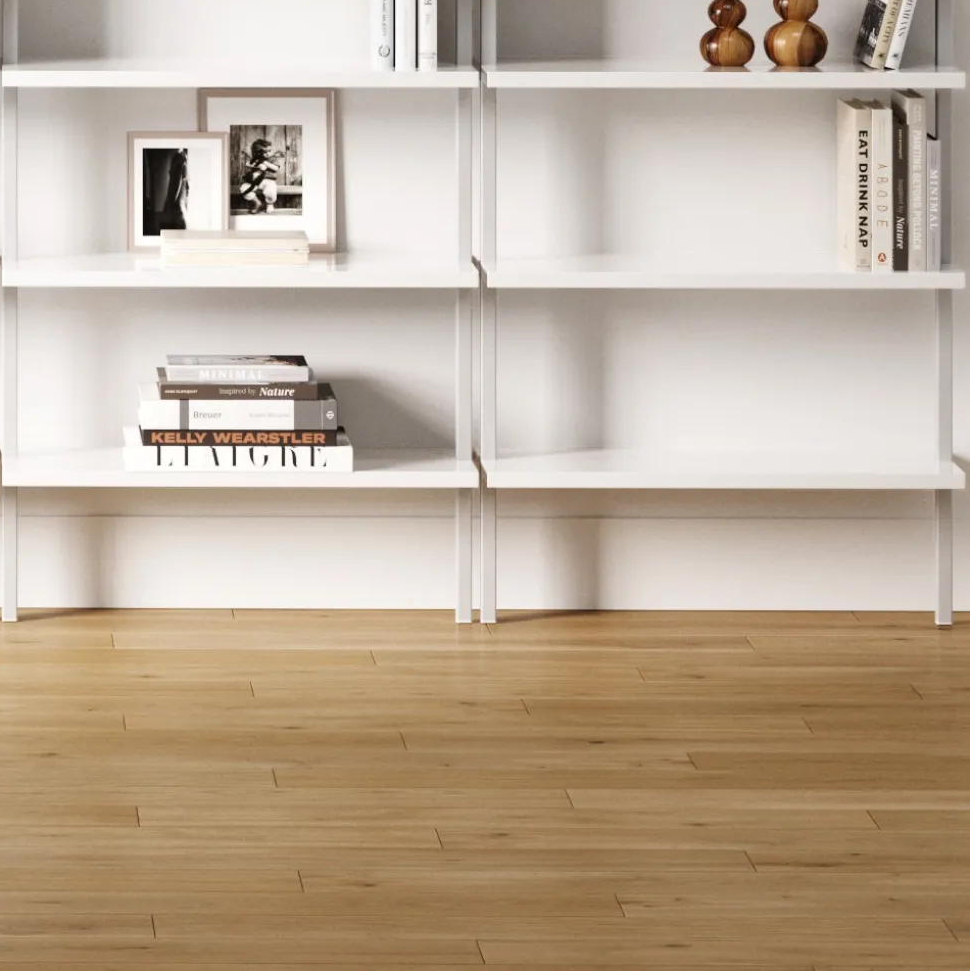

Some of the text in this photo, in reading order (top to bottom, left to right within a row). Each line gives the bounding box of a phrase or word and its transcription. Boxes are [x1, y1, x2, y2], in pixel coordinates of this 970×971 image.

[858, 130, 868, 247] EAT DRINK NAP
[930, 169, 938, 230] MINIMAL
[896, 216, 905, 250] Nature
[199, 369, 264, 380] MINIMAL
[219, 386, 295, 397] Inspired by Nature
[193, 411, 222, 419] Breuer
[151, 432, 326, 444] KELLY WEARSTLER
